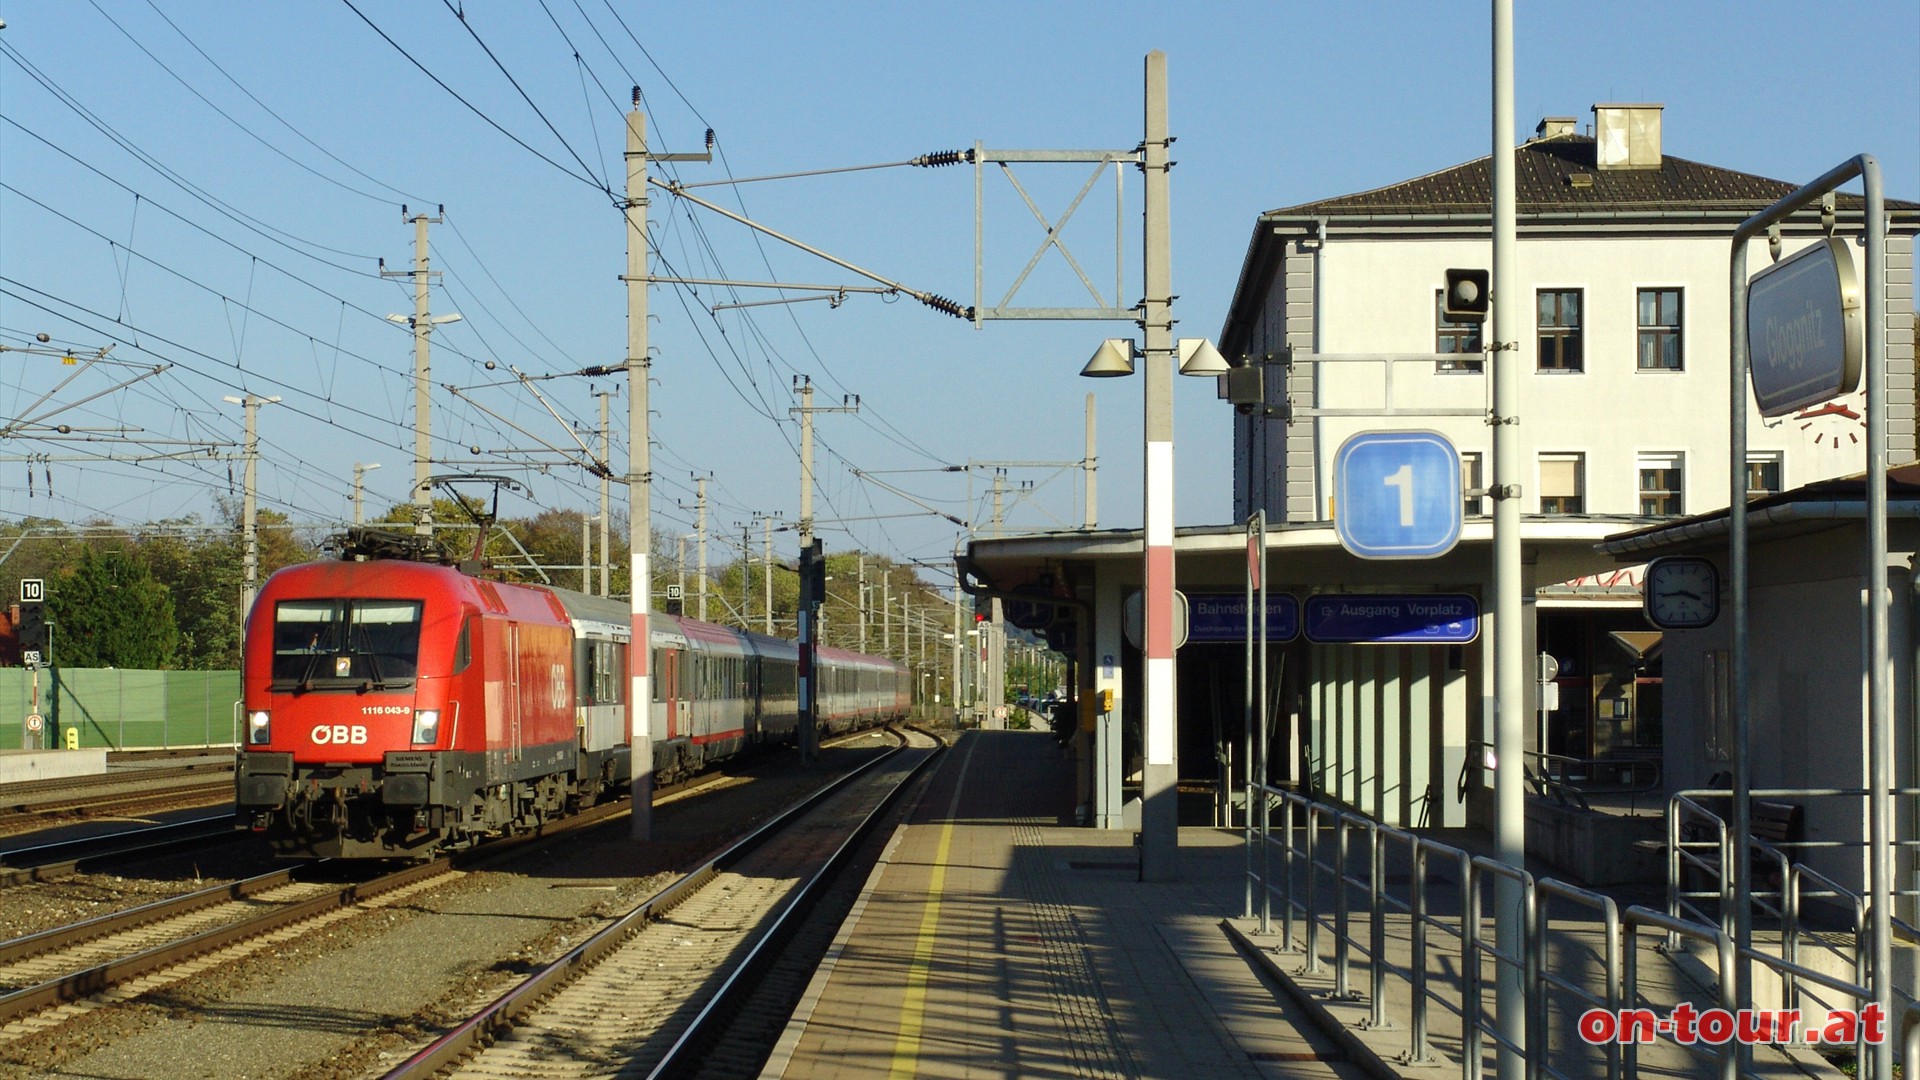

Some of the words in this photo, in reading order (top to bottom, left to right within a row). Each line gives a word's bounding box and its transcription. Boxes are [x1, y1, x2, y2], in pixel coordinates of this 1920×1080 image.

[1766, 300, 1826, 370] Gloggnitz
[1384, 464, 1414, 527] 1
[24, 583, 40, 597] 10
[670, 587, 680, 597] 10
[1340, 604, 1399, 618] Ausgang
[1407, 603, 1463, 618] Vorplatz
[25, 652, 39, 662] AS
[551, 663, 566, 710] ÖBB
[361, 706, 384, 715] 1116
[385, 706, 410, 715] 043-9
[311, 725, 368, 745] ÖBB
